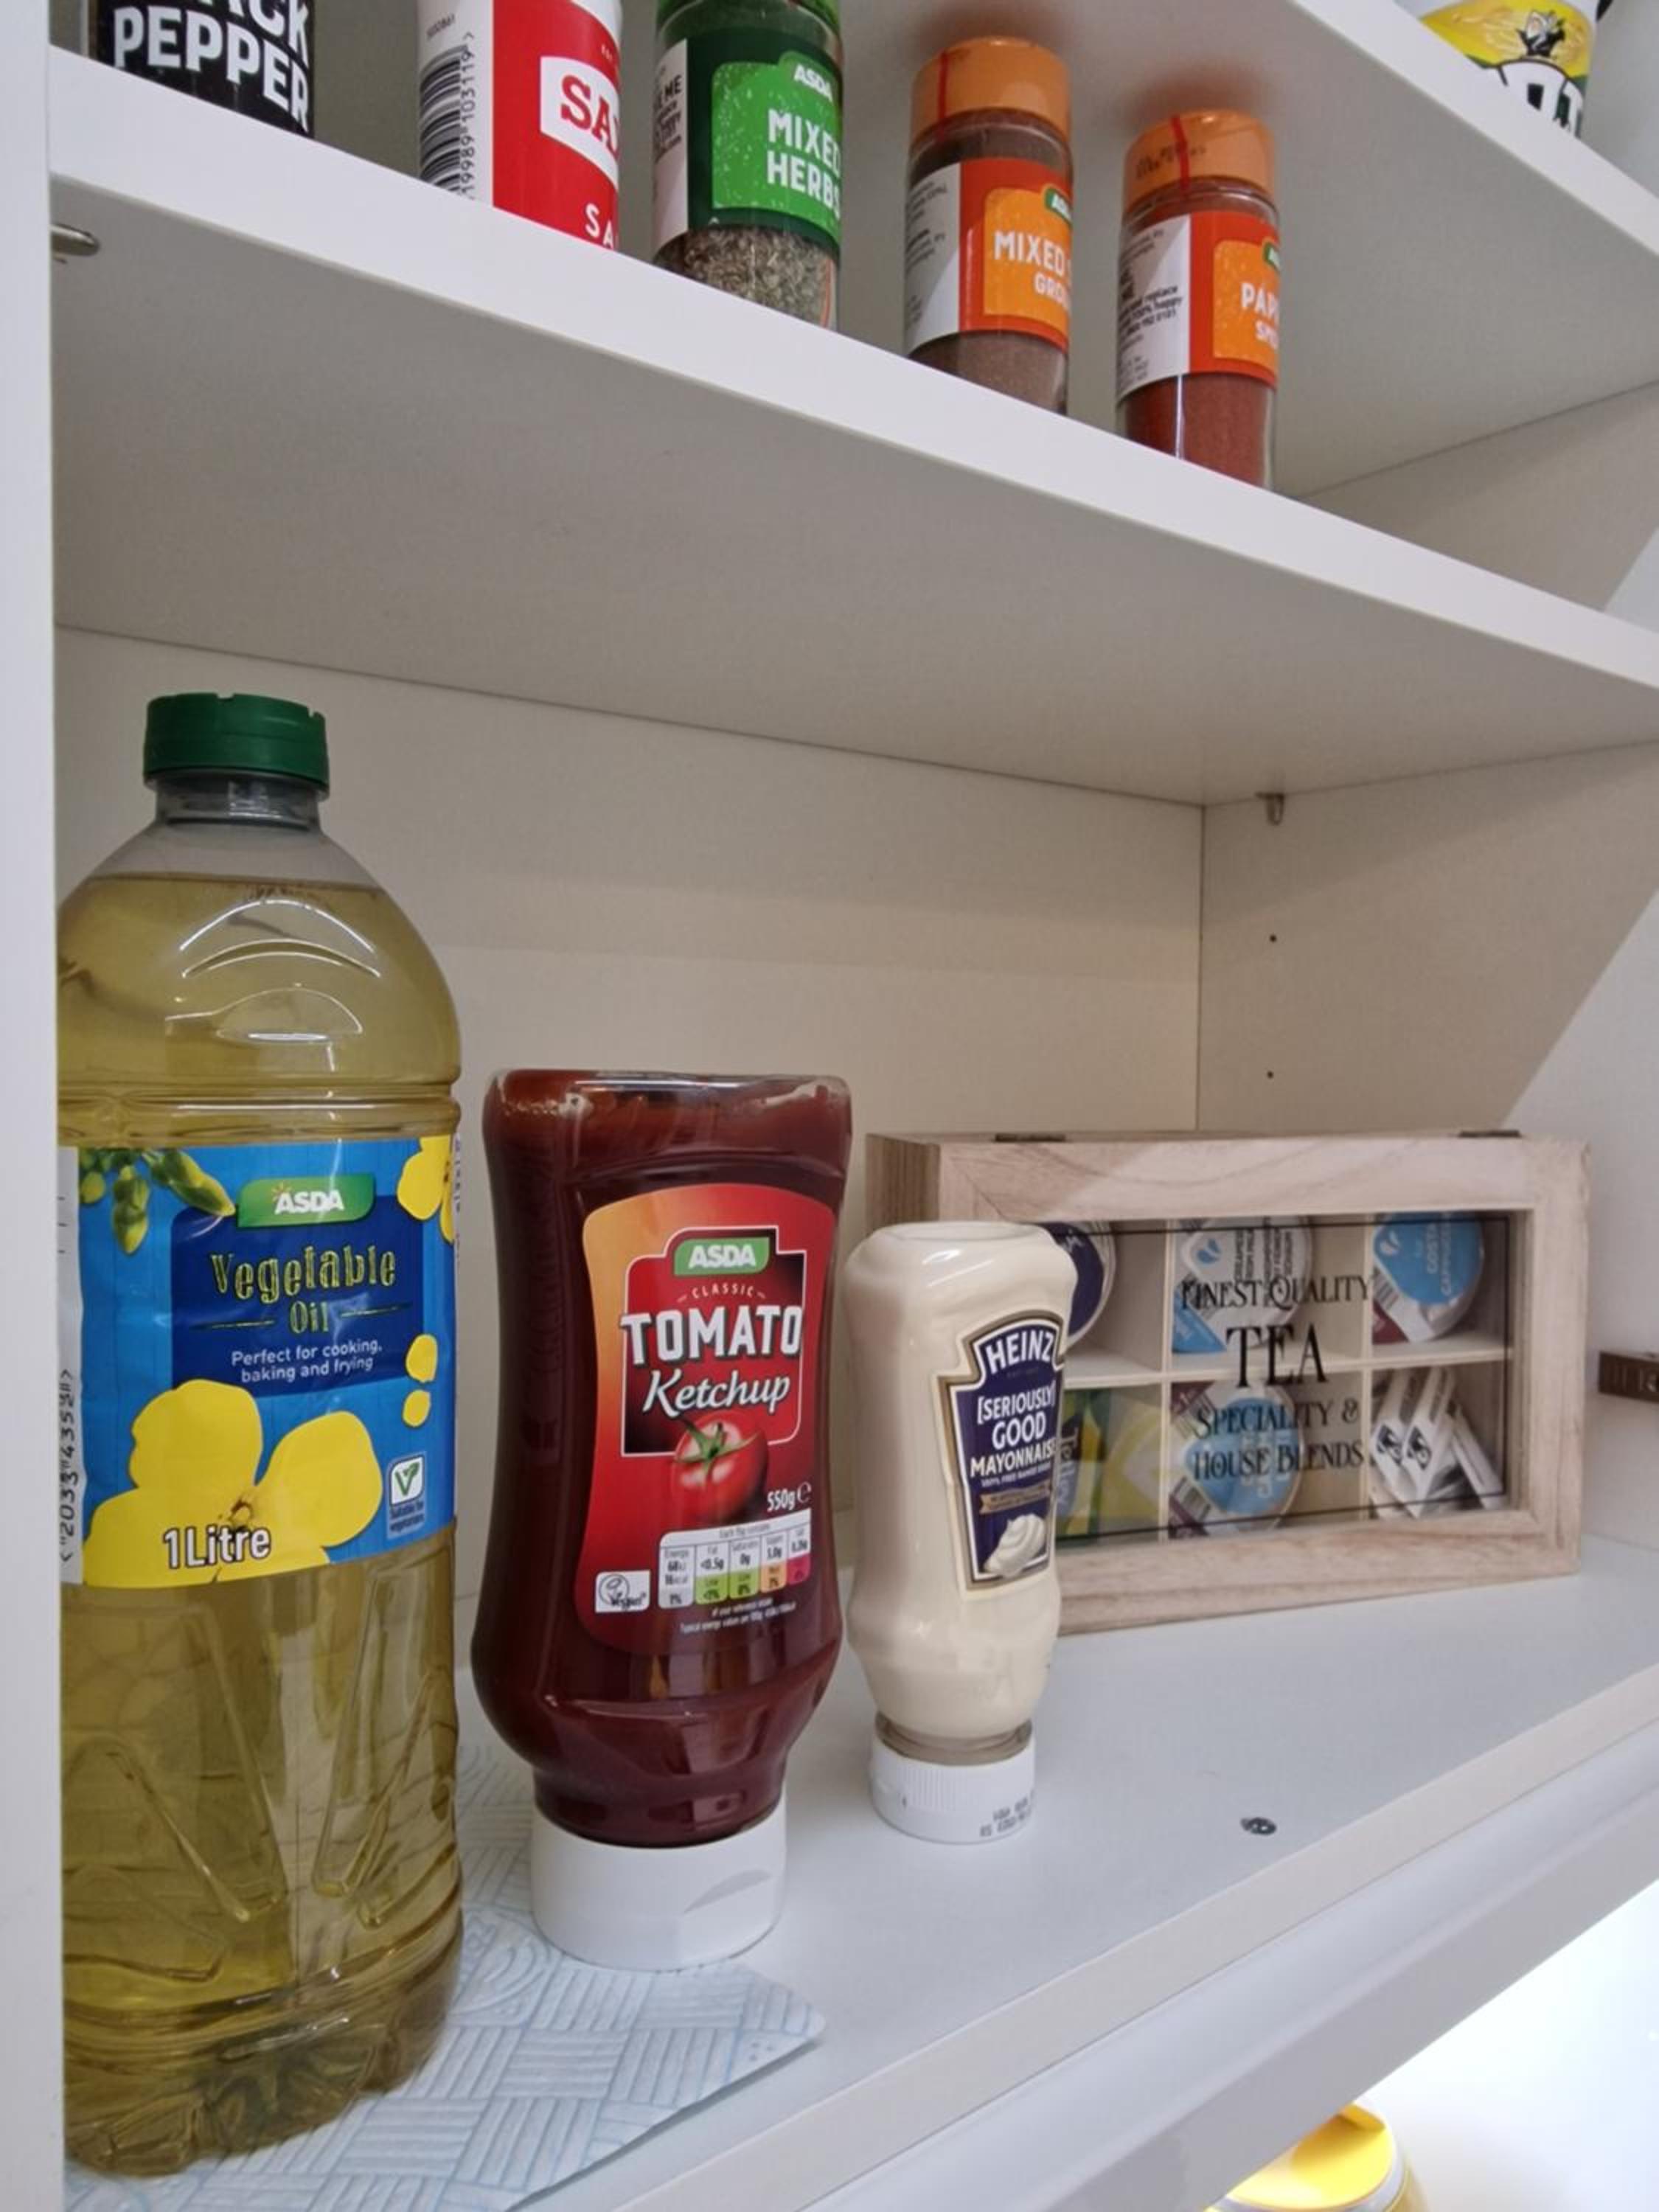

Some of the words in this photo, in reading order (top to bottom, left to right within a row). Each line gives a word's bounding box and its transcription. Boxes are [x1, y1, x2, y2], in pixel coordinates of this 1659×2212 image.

[113, 4, 310, 133] PEPPER
[793, 63, 832, 102] ASDA
[768, 108, 841, 178] MIXED
[767, 150, 841, 221] HERBS
[993, 229, 1066, 277] MIXED
[274, 1189, 345, 1215] ASDA
[209, 1245, 396, 1304] Vegetable
[688, 1243, 757, 1270] ASDA
[691, 1282, 754, 1299] CLASSIC
[1181, 1279, 1263, 1310] FINEST
[1269, 1275, 1369, 1311] QUALITY
[289, 1300, 330, 1334] Oil
[620, 1304, 803, 1366] TOMATO
[232, 1348, 291, 1366] Perfect
[296, 1344, 317, 1360] for
[241, 1368, 296, 1383] baking
[300, 1360, 330, 1377] and
[333, 1356, 374, 1374] frying
[984, 1329, 1055, 1374] HEINZ
[1225, 1323, 1329, 1388] TEA
[642, 1367, 791, 1418] Ketchup
[991, 1411, 1047, 1450] GOOD
[1195, 1402, 1334, 1439] SPECIALITY
[1342, 1397, 1359, 1423] &
[1193, 1447, 1271, 1481] HOUSE
[1276, 1441, 1364, 1473] BLENDS
[766, 1487, 796, 1512] 550g
